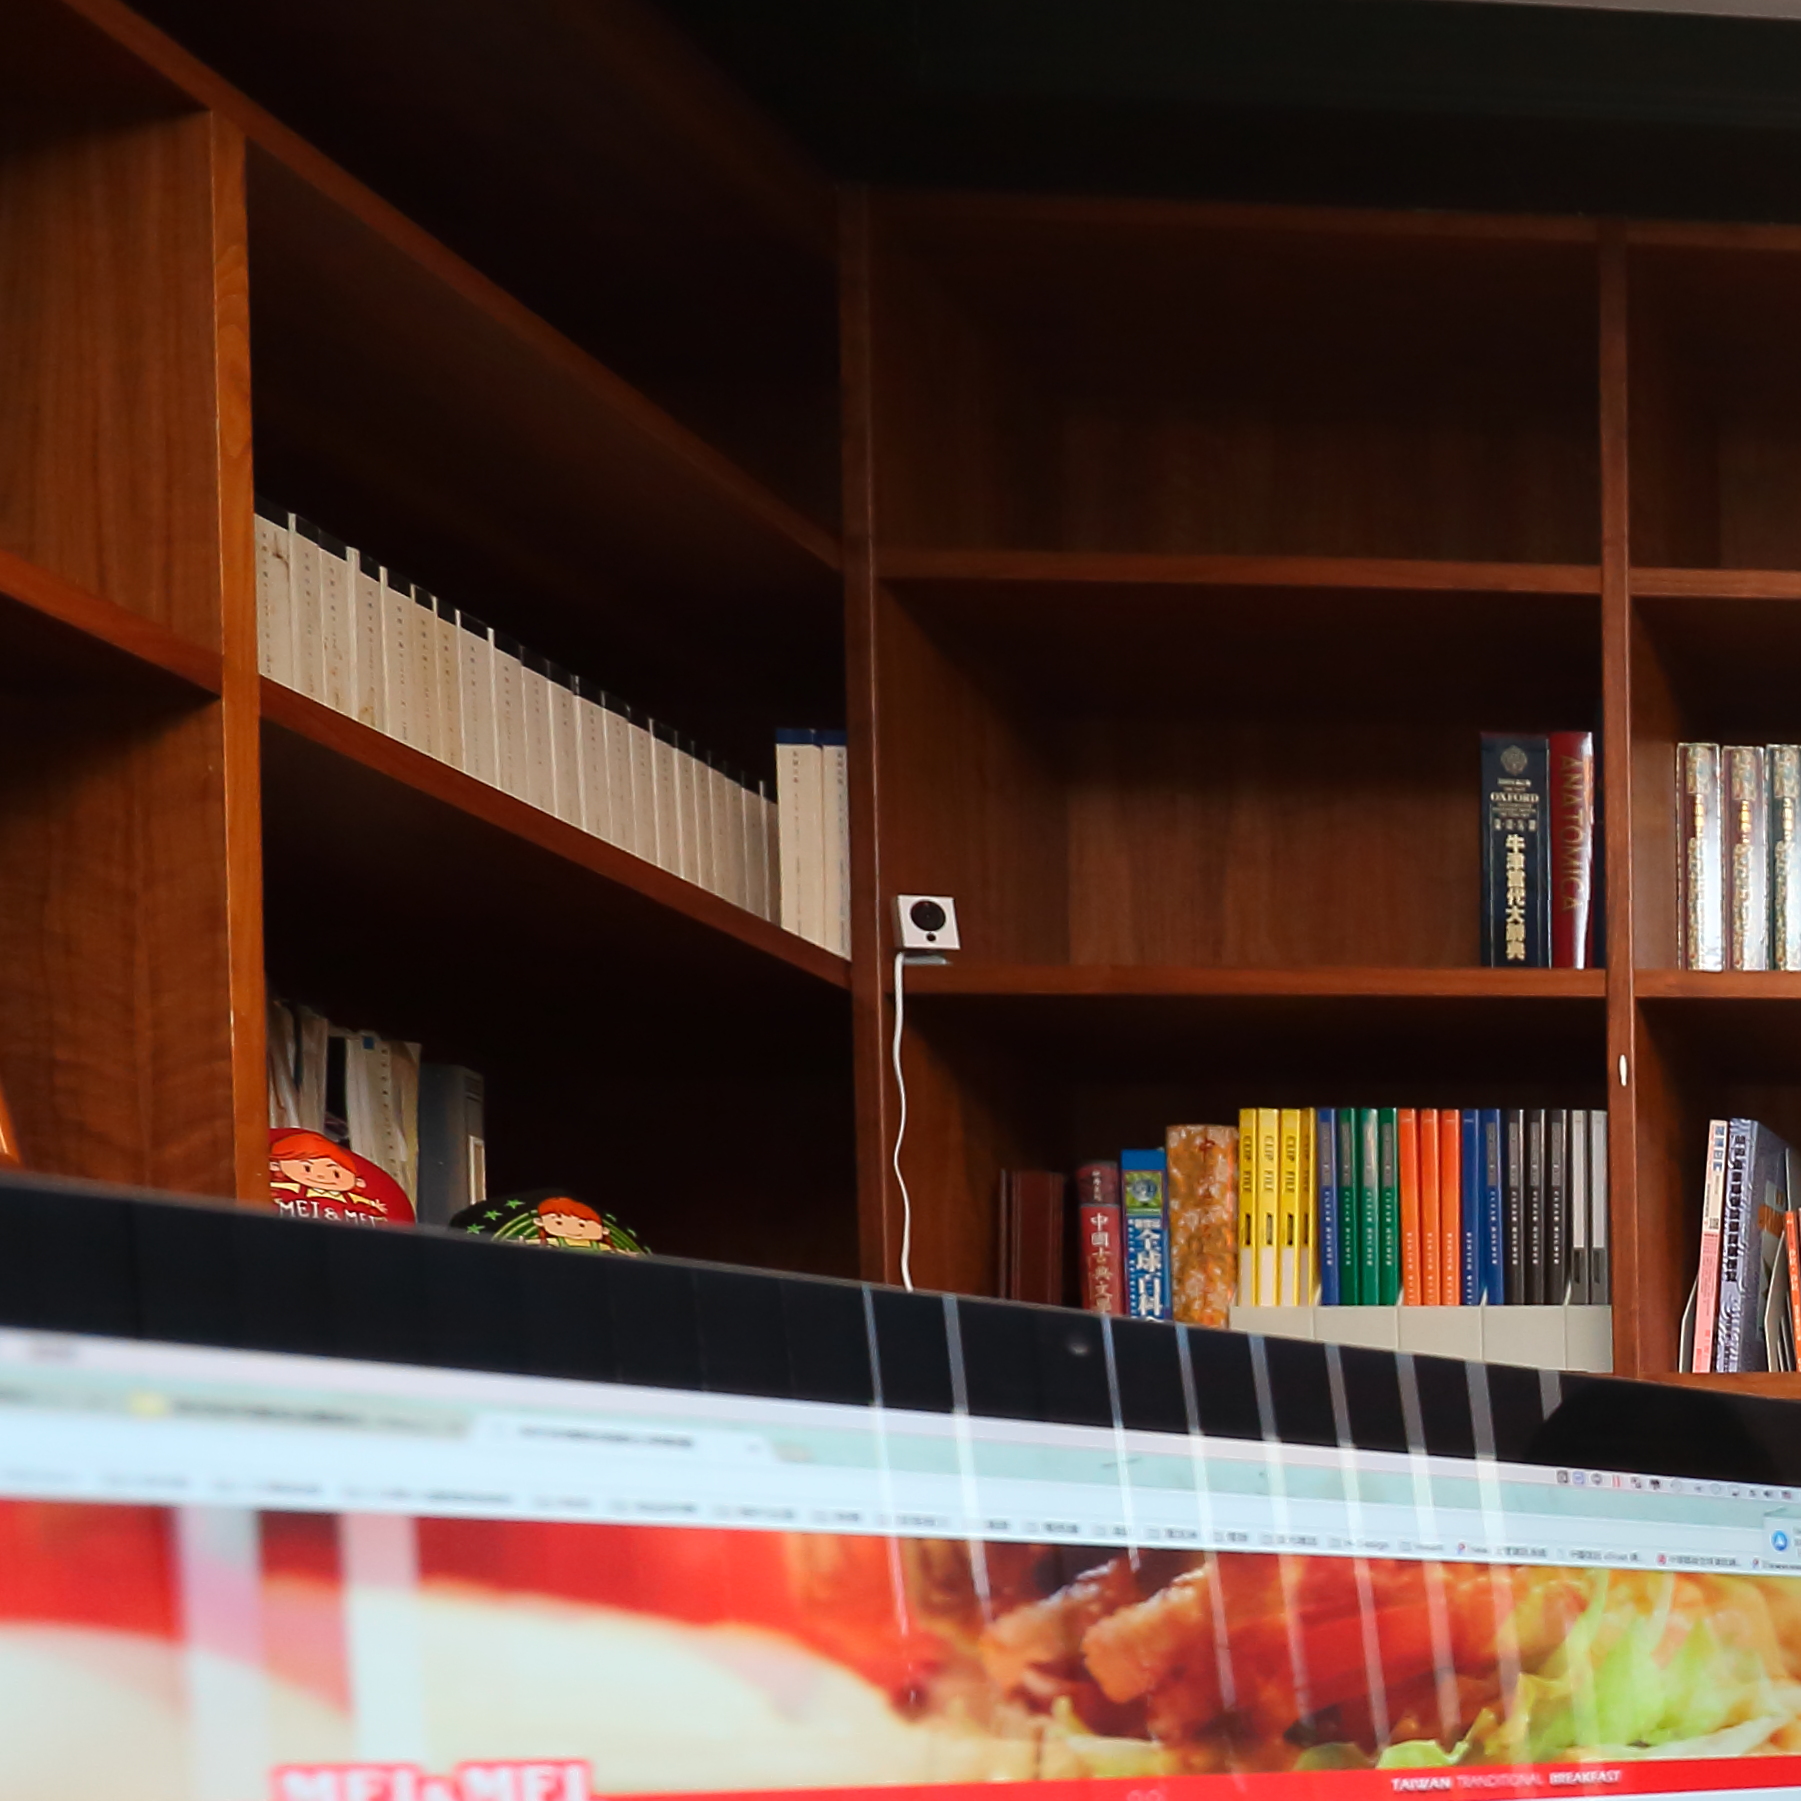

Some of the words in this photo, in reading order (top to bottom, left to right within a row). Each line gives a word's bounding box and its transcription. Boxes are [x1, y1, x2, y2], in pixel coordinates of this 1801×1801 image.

[1490, 792, 1539, 802] OXFORD
[1561, 756, 1583, 910] ANATOMICA
[279, 1200, 320, 1218] MEI
[324, 1207, 340, 1221] &
[1392, 1777, 1451, 1791] TAIWAN
[1550, 1770, 1621, 1785] BREAKFAST
